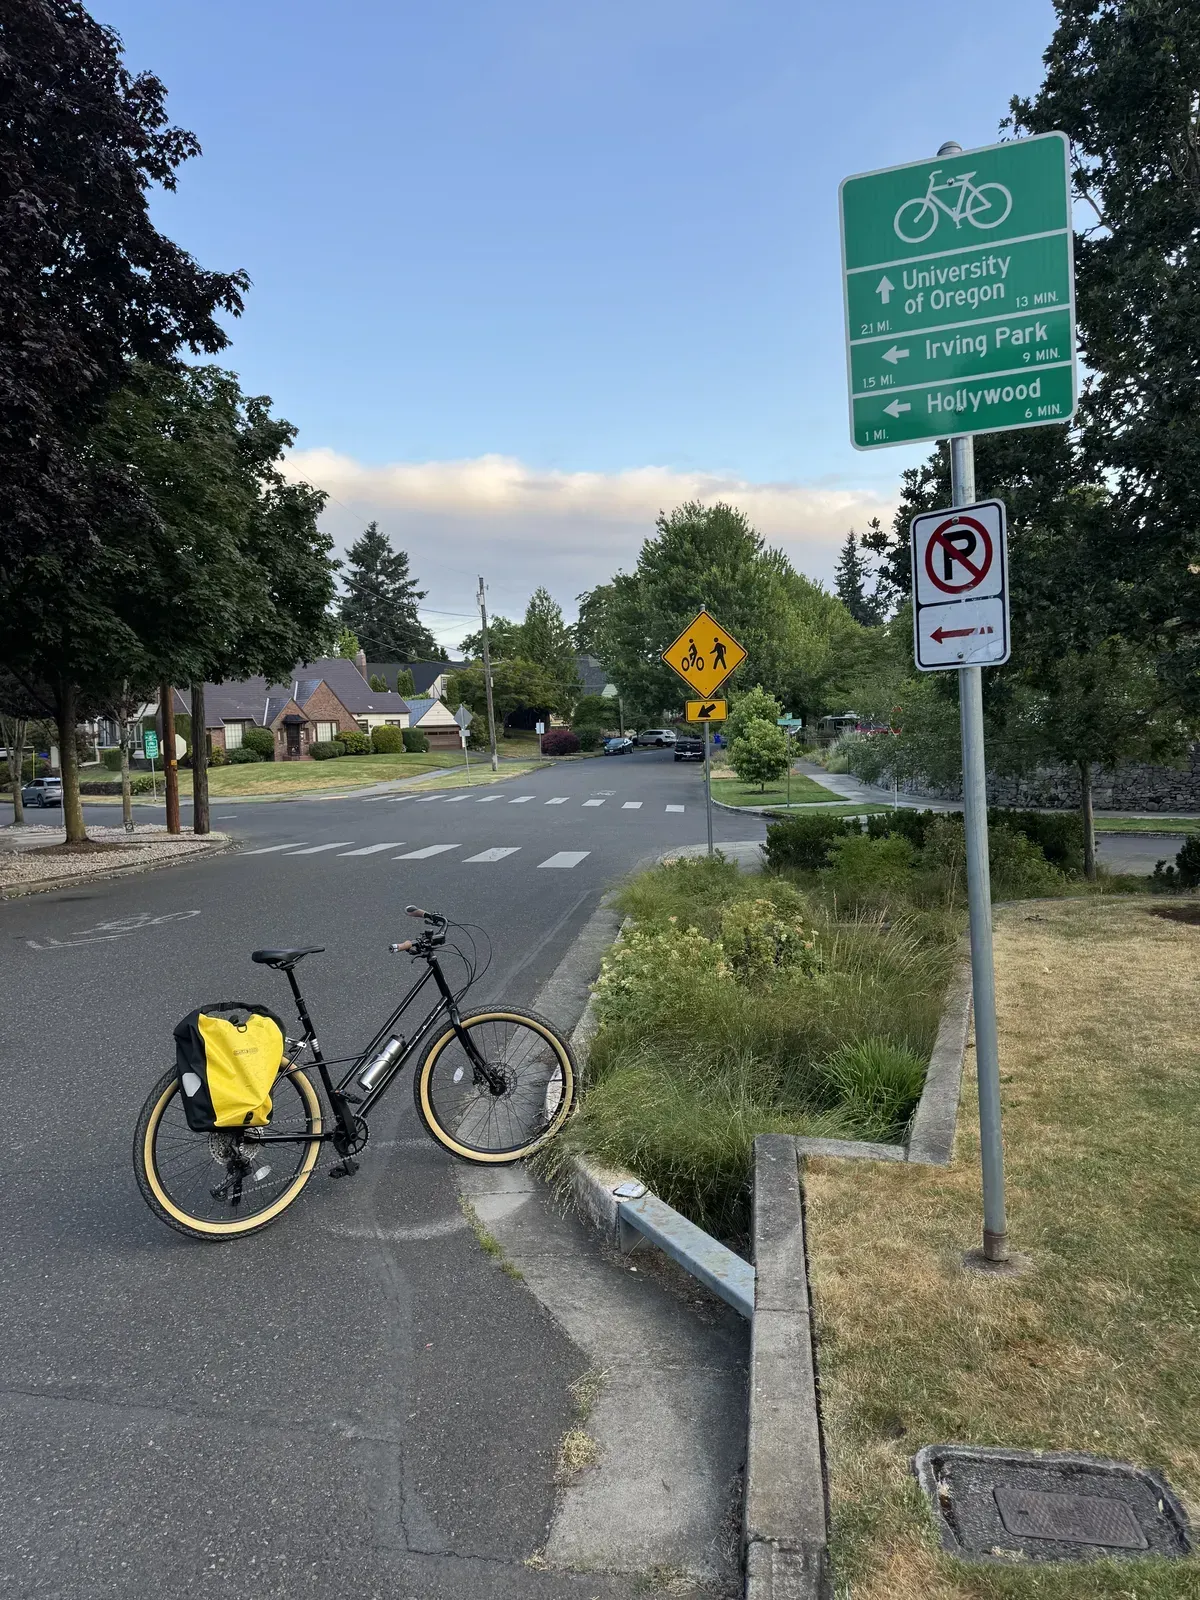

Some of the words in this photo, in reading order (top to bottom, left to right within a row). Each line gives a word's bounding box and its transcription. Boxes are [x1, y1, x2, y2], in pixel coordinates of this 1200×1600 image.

[902, 255, 1011, 290] University
[904, 293, 924, 315] of
[930, 282, 1005, 310] Oregon
[1015, 296, 1029, 308] 13
[1033, 291, 1059, 305] MIN.
[860, 323, 874, 335] 2.1
[877, 320, 893, 332] MI.
[925, 334, 987, 359] Irving
[995, 321, 1048, 349] Park
[1022, 352, 1031, 363] 9
[1035, 347, 1061, 361] MIN.
[880, 374, 896, 386] MI.
[927, 377, 1041, 414] Hollywood
[1024, 408, 1033, 419] 6
[1037, 403, 1063, 417] MIN.
[865, 431, 869, 441] 1
[873, 429, 889, 441] MI.
[942, 529, 977, 581] P
